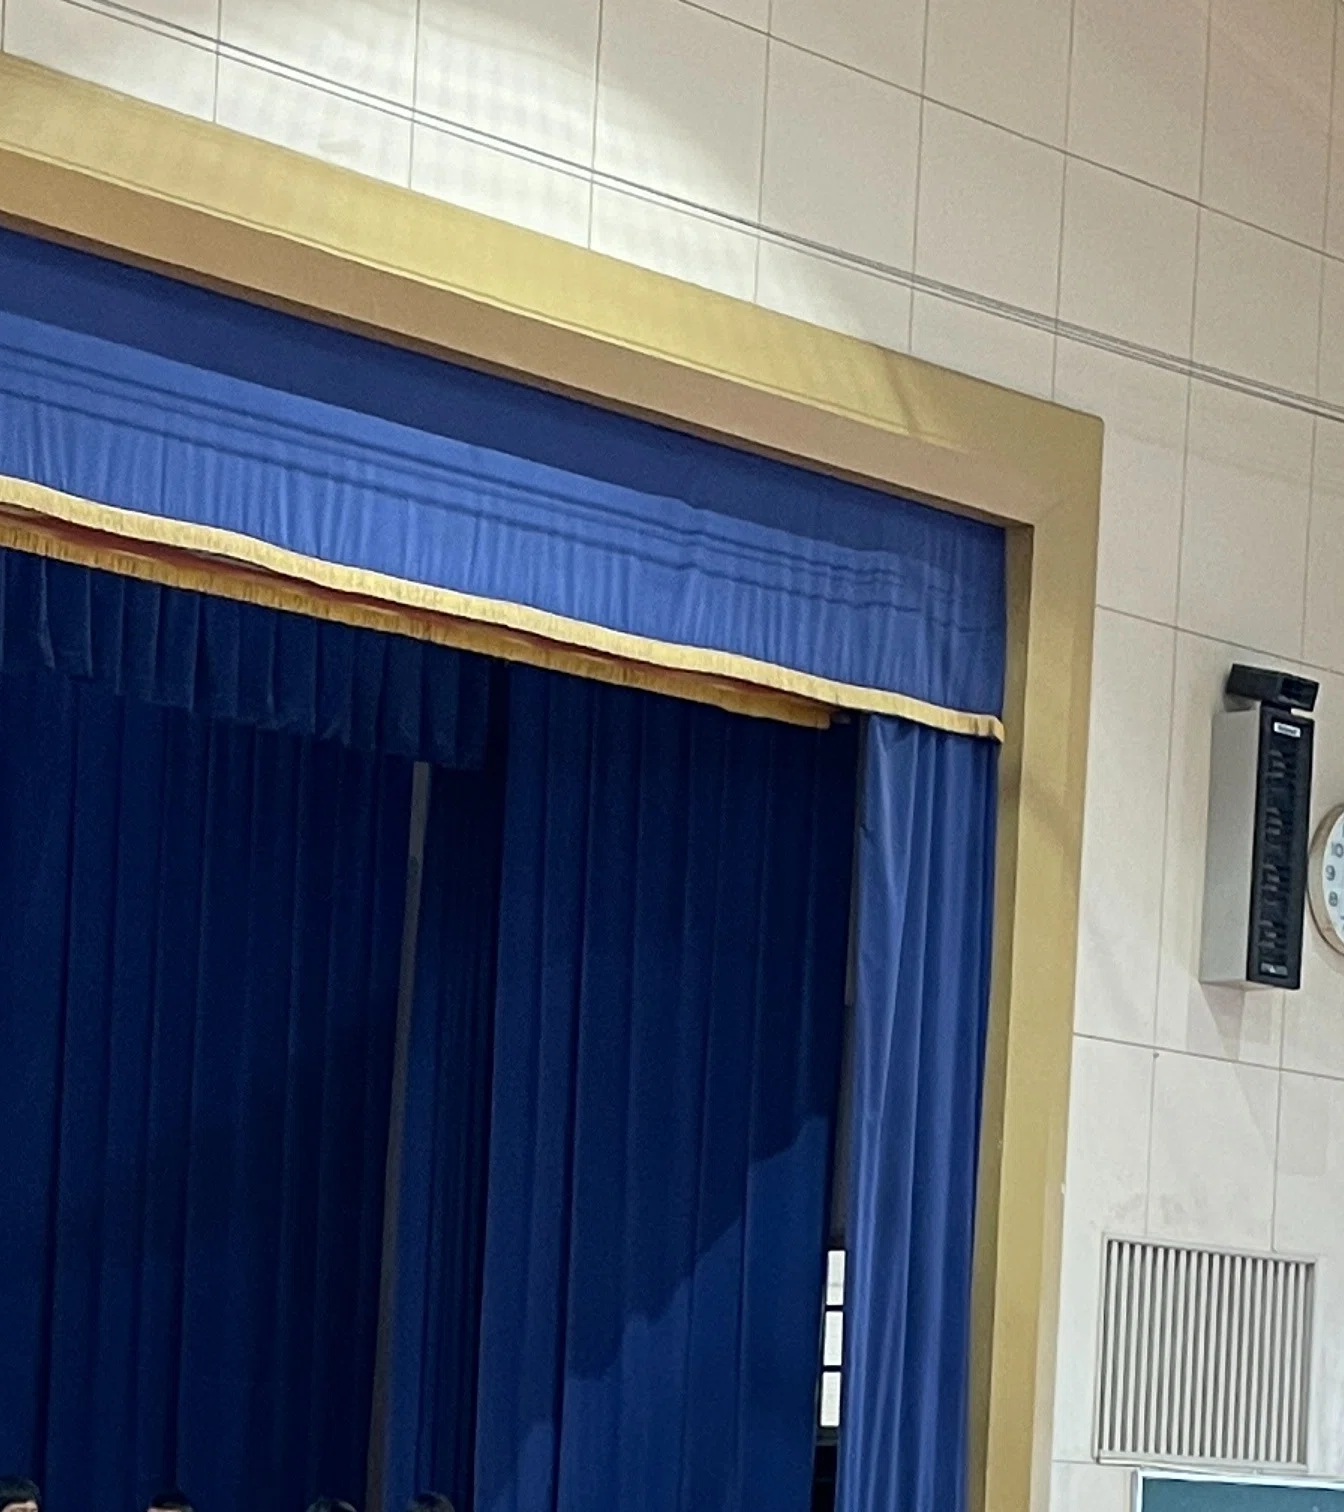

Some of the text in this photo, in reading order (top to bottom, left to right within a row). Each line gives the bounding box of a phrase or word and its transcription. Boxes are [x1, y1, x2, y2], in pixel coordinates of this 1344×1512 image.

[1331, 842, 1344, 858] 10
[1325, 865, 1336, 881] 9
[1328, 891, 1338, 907] 8
